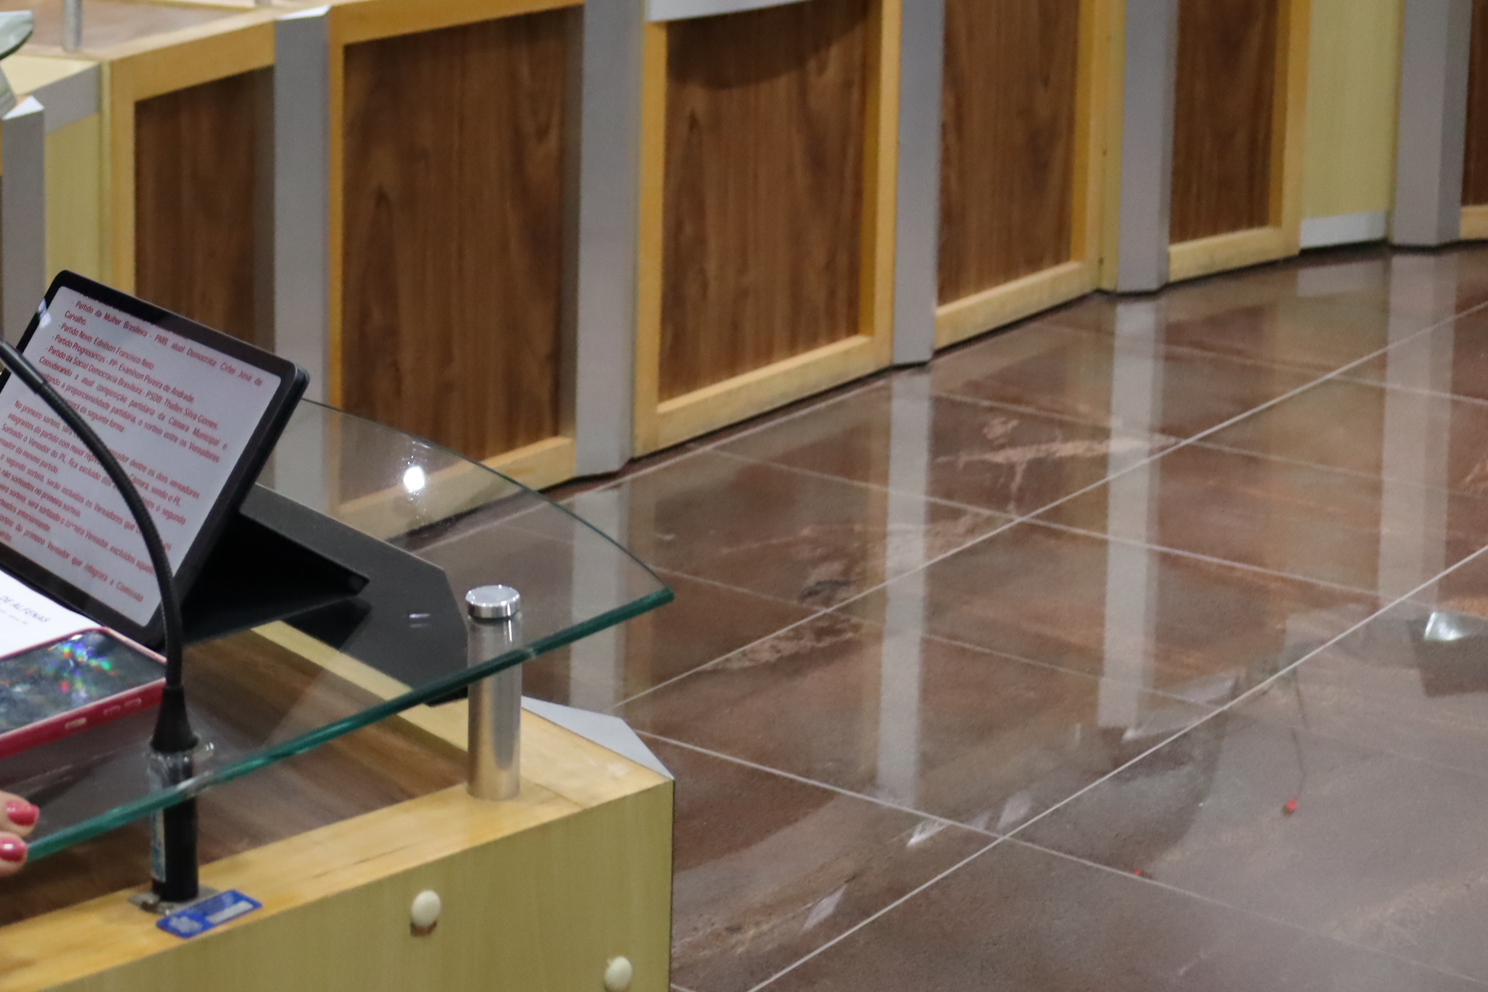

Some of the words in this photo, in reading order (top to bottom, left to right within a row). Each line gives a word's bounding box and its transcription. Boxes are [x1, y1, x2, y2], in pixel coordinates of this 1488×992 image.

[60, 322, 80, 336] Partido
[53, 334, 73, 347] Partido
[47, 345, 67, 359] Partido
[64, 353, 74, 362] da
